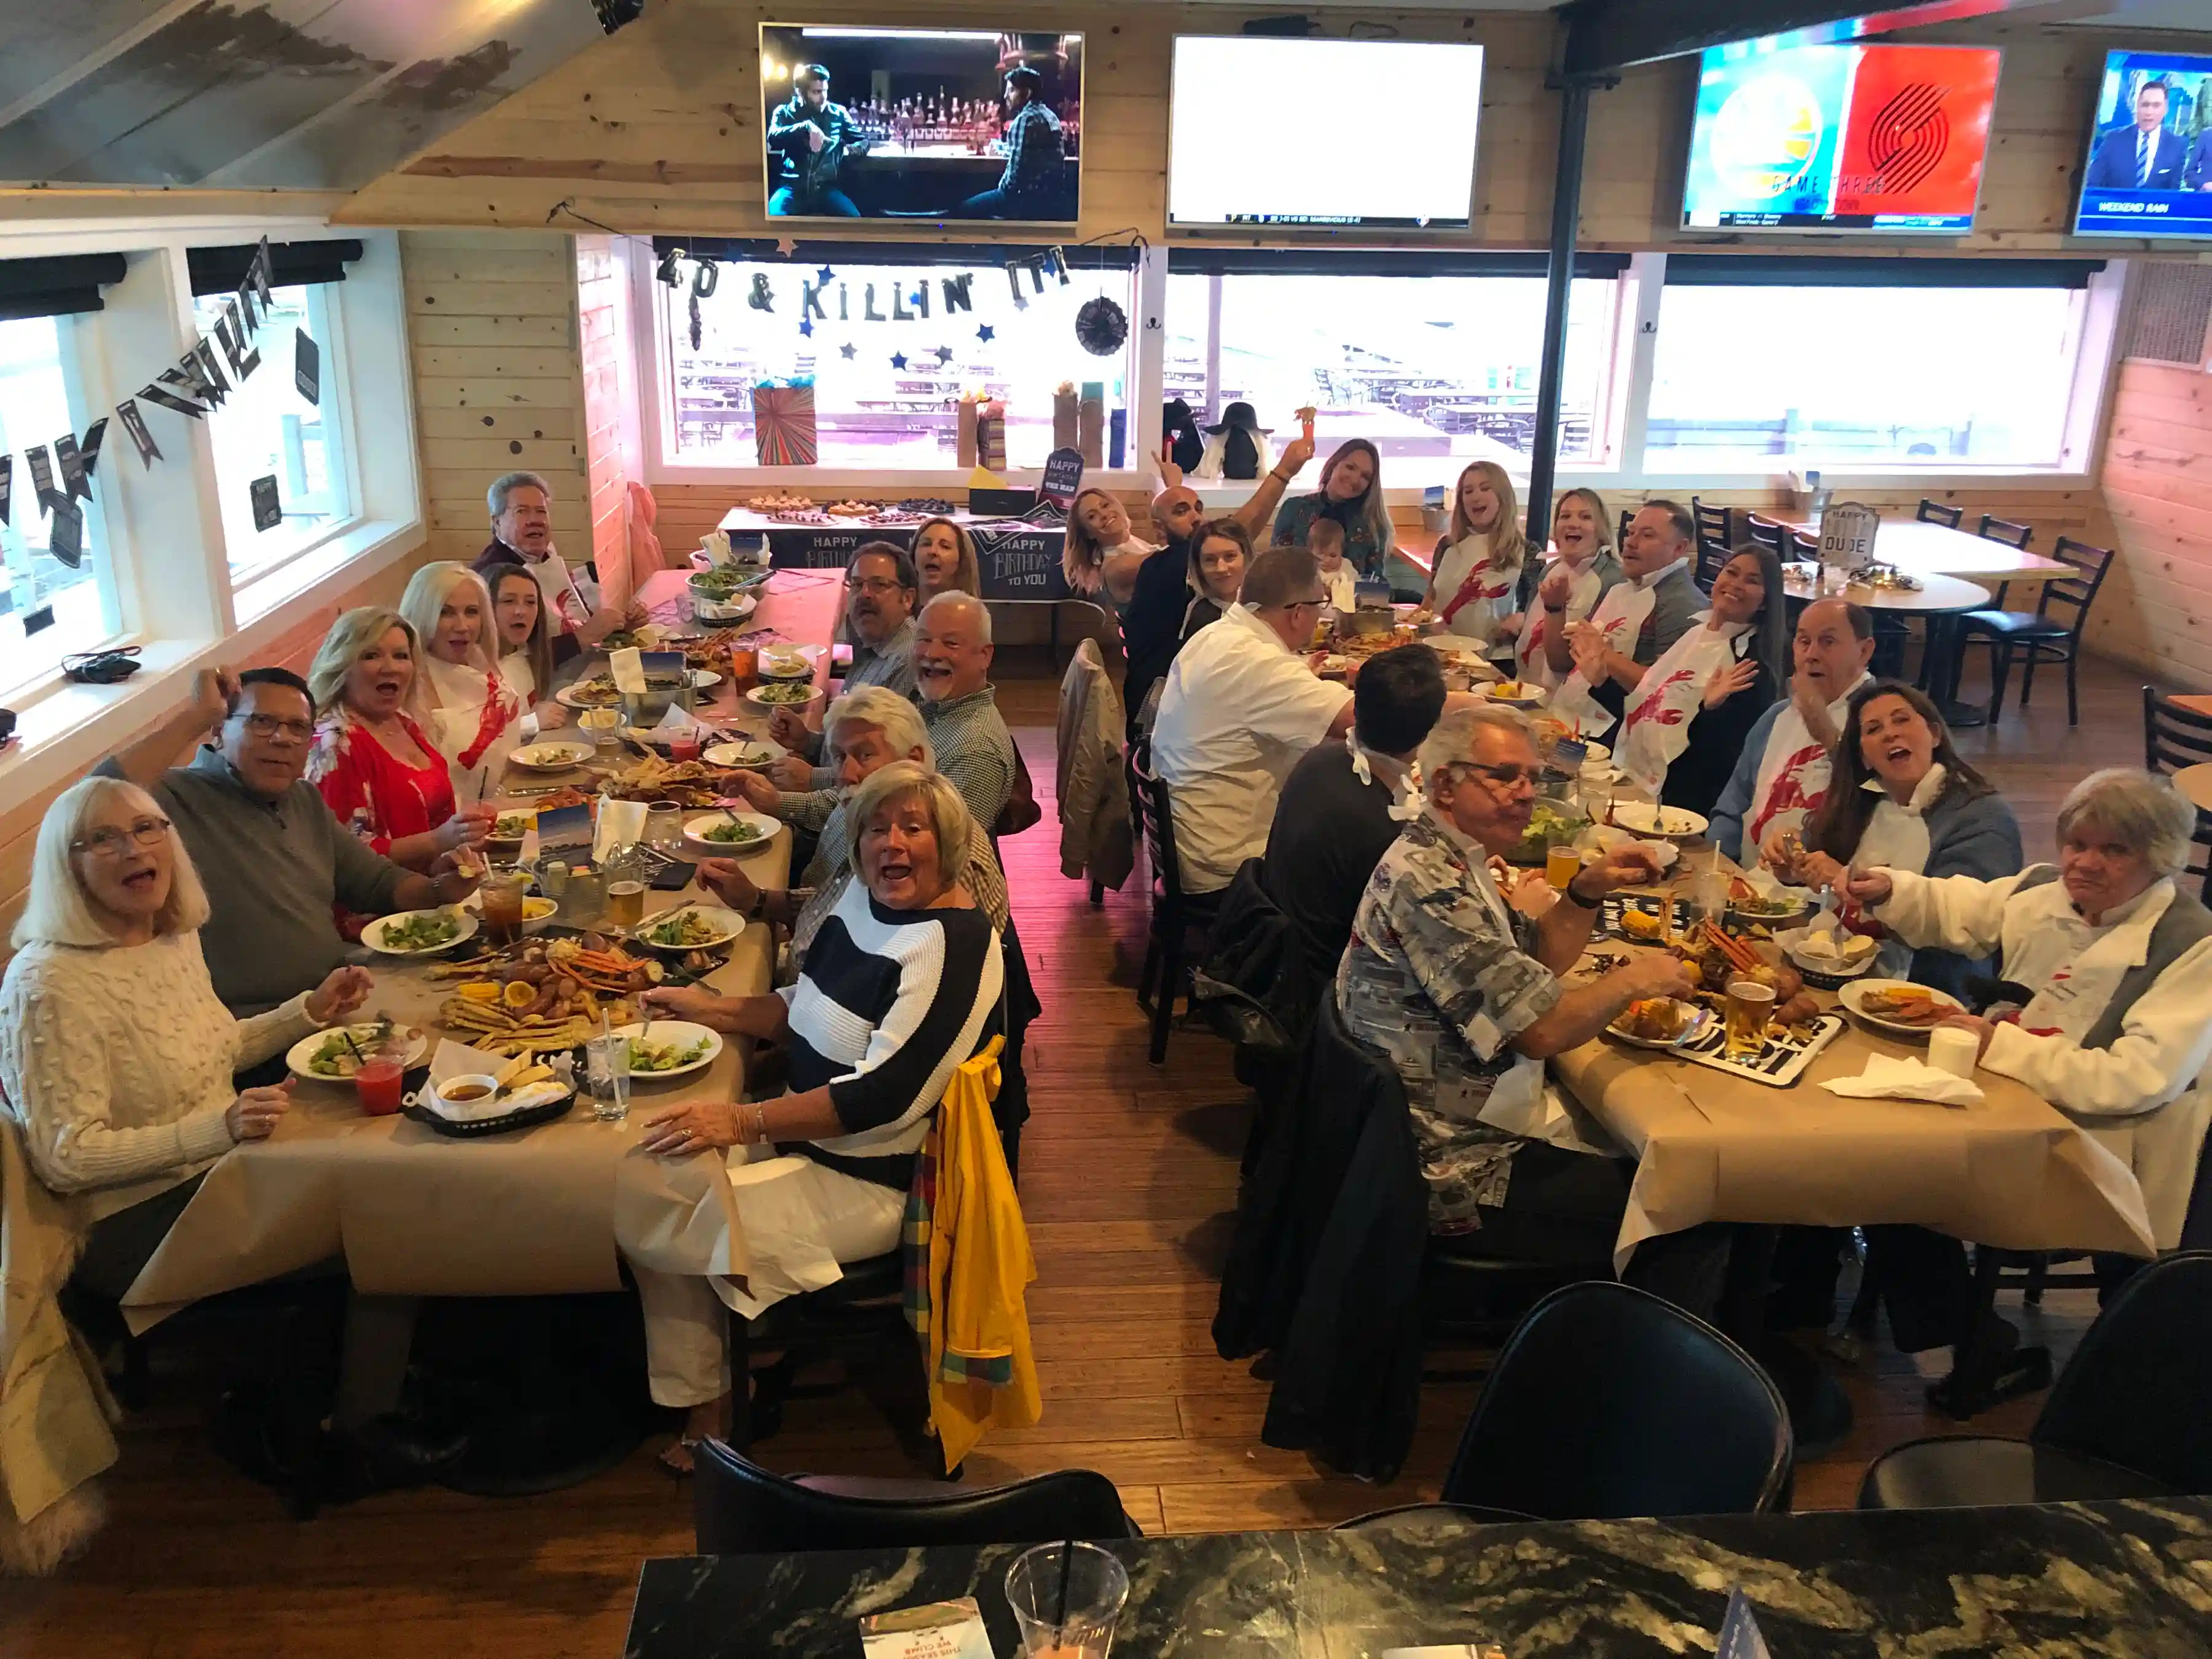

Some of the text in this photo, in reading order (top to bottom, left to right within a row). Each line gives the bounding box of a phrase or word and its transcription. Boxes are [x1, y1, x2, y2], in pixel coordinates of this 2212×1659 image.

[1772, 175, 1886, 194] GAME HREE
[2099, 202, 2145, 213] WEEKEND
[1049, 459, 1080, 473] HAPPY
[814, 536, 858, 547] HAPPY
[1002, 539, 1045, 551] HAPPY
[992, 552, 1053, 579] BIRTHDAY
[1008, 573, 1047, 586] TO YOU
